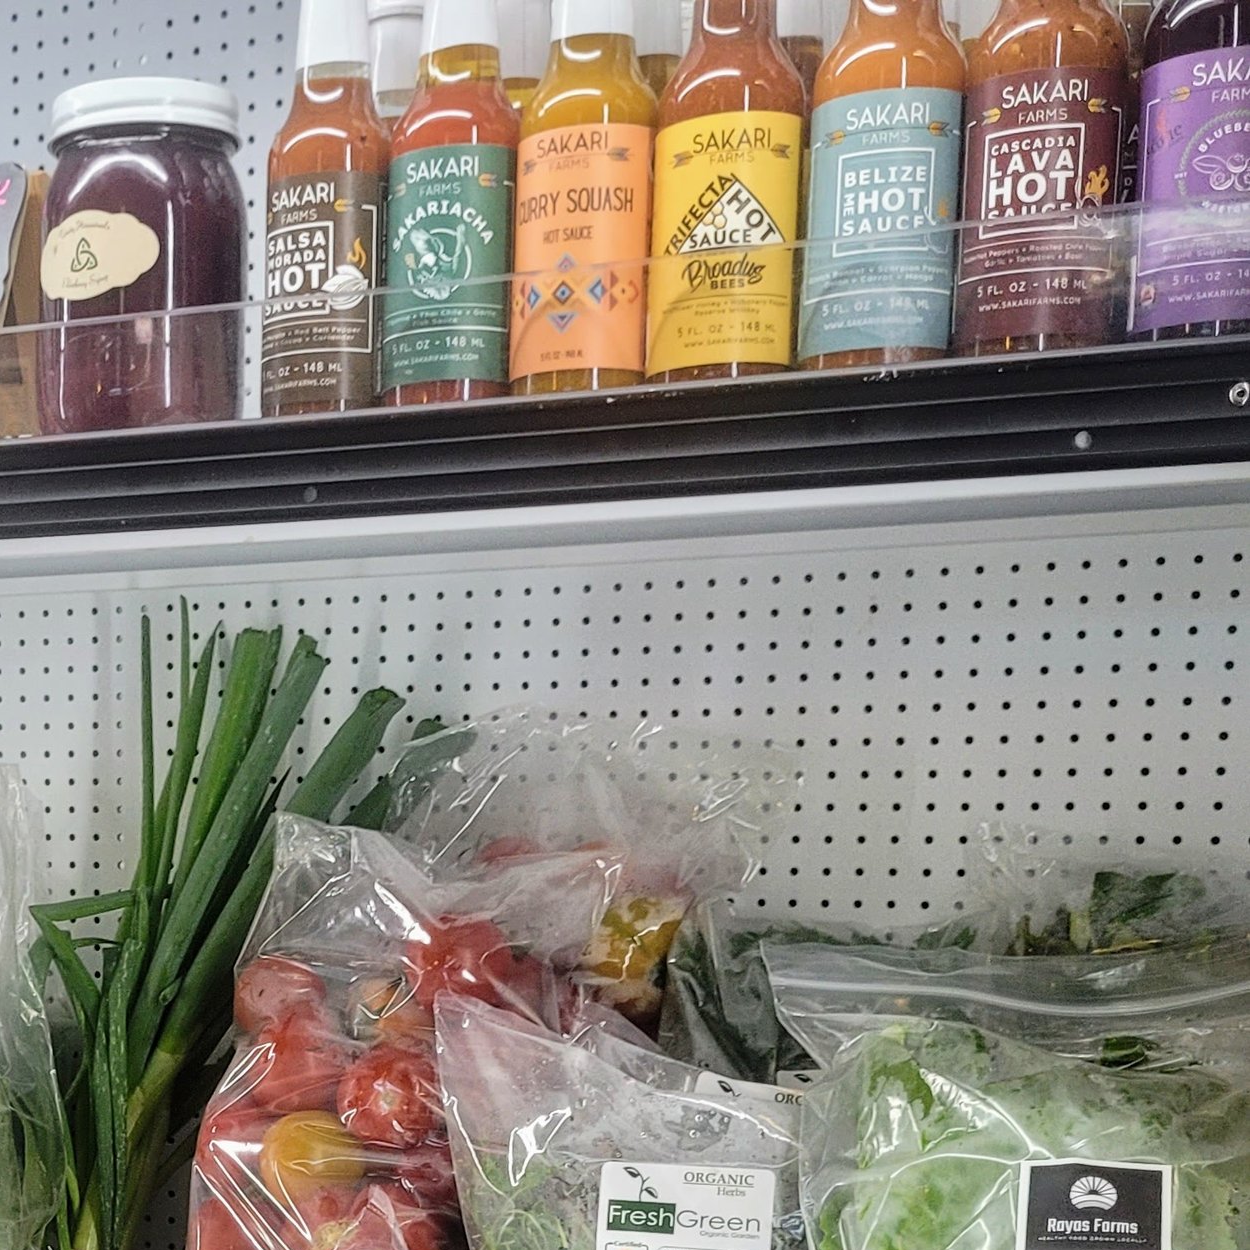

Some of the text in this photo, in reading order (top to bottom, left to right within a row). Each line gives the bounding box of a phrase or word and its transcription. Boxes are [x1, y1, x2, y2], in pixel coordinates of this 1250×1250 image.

[1001, 79, 1089, 109] SAKARI
[846, 102, 930, 131] SAKARI
[1018, 109, 1068, 125] FARMS
[537, 131, 608, 159] SAKARI
[692, 127, 771, 154] SAKARI
[862, 129, 911, 146] FARMS
[991, 136, 1076, 156] CASCADIA
[406, 155, 480, 184] SAKARI
[710, 151, 755, 166] FARMS
[990, 151, 1074, 178] LAVA
[844, 166, 927, 188] BELIZE
[271, 182, 335, 212] SAKARI
[419, 182, 462, 198] FARMS
[988, 170, 1074, 209] HOT
[519, 188, 634, 226] CURRY SQUASH
[857, 188, 925, 215] HOT
[281, 210, 318, 226] FARMS
[664, 172, 738, 256] TRIFECTA
[726, 188, 776, 242] HOT
[392, 200, 495, 252] SAKARIACHA
[543, 225, 594, 244] HOT SAUCE
[268, 230, 326, 256] SALSA
[689, 229, 752, 248] SAUCE
[268, 262, 326, 298] HOT
[710, 278, 745, 290] BEES
[1009, 277, 1067, 293] OZ 148
[446, 336, 466, 347] 148
[303, 363, 322, 374] 148
[683, 1171, 755, 1187] ORGANIC
[717, 1187, 746, 1197] Herbs
[1047, 1218, 1138, 1234] Rayas Farms
